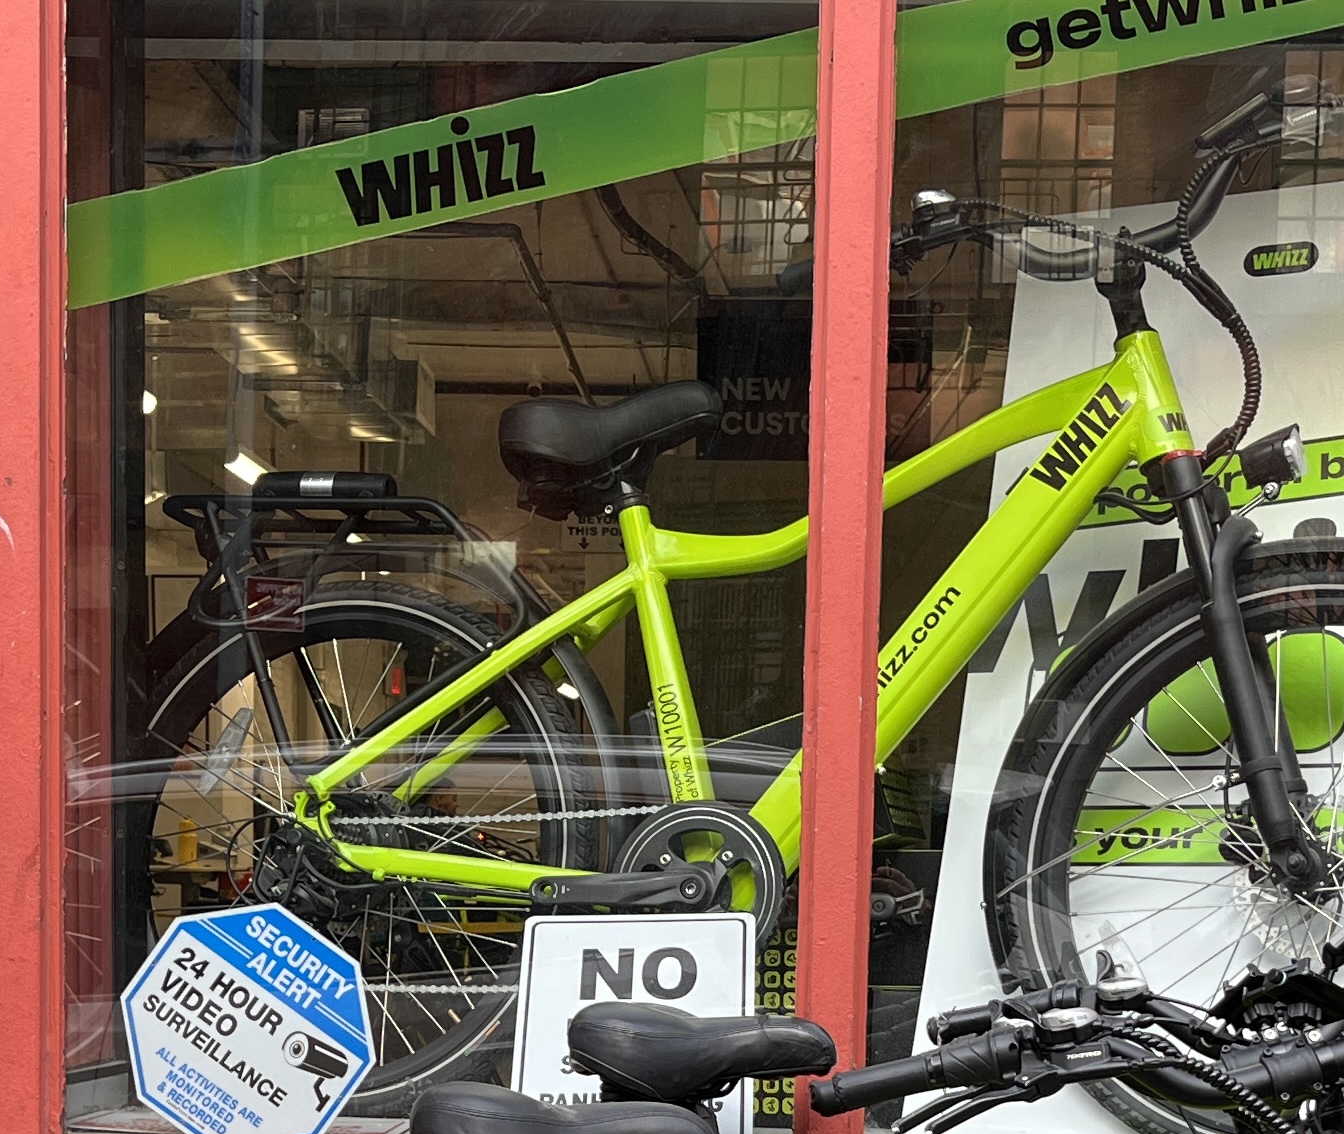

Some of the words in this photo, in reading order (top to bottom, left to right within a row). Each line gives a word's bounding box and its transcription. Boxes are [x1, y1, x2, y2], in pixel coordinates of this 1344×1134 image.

[722, 377, 791, 400] NEW
[1029, 382, 1132, 491] WHIZZ
[568, 527, 597, 536] THIS
[1096, 826, 1203, 855] your
[246, 915, 354, 1000] SECURITY
[247, 952, 321, 1009] ALERT
[579, 947, 697, 1000] NO
[159, 969, 238, 1037] VIDEO
[173, 947, 211, 980] 24
[209, 971, 284, 1036] HOUR
[143, 994, 288, 1107] SURVEILLANCE
[156, 1047, 176, 1068] ALL
[179, 1063, 239, 1111] ACTIVITIES
[238, 1107, 263, 1128] ARE
[157, 1082, 166, 1093] &
[166, 1070, 235, 1124] MONITORED
